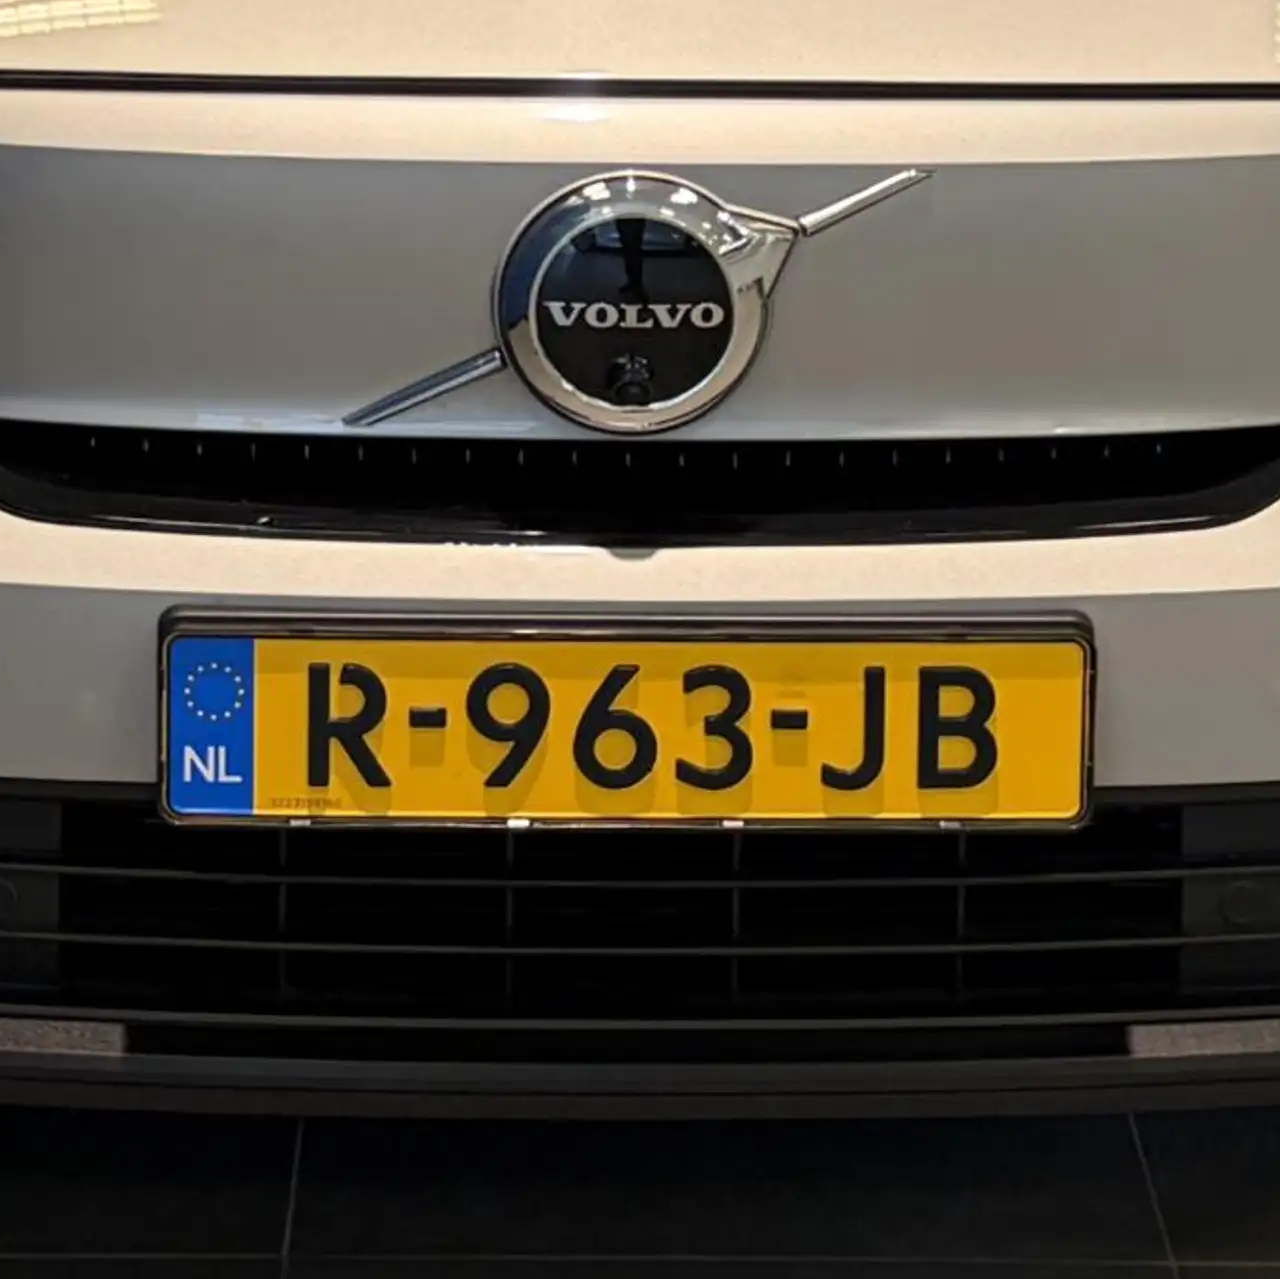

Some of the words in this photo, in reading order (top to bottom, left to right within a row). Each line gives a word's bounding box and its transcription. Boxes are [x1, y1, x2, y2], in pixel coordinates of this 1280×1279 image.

[543, 301, 725, 329] VOLVO
[182, 745, 244, 784] NL
[306, 662, 999, 791] R-963-JB
